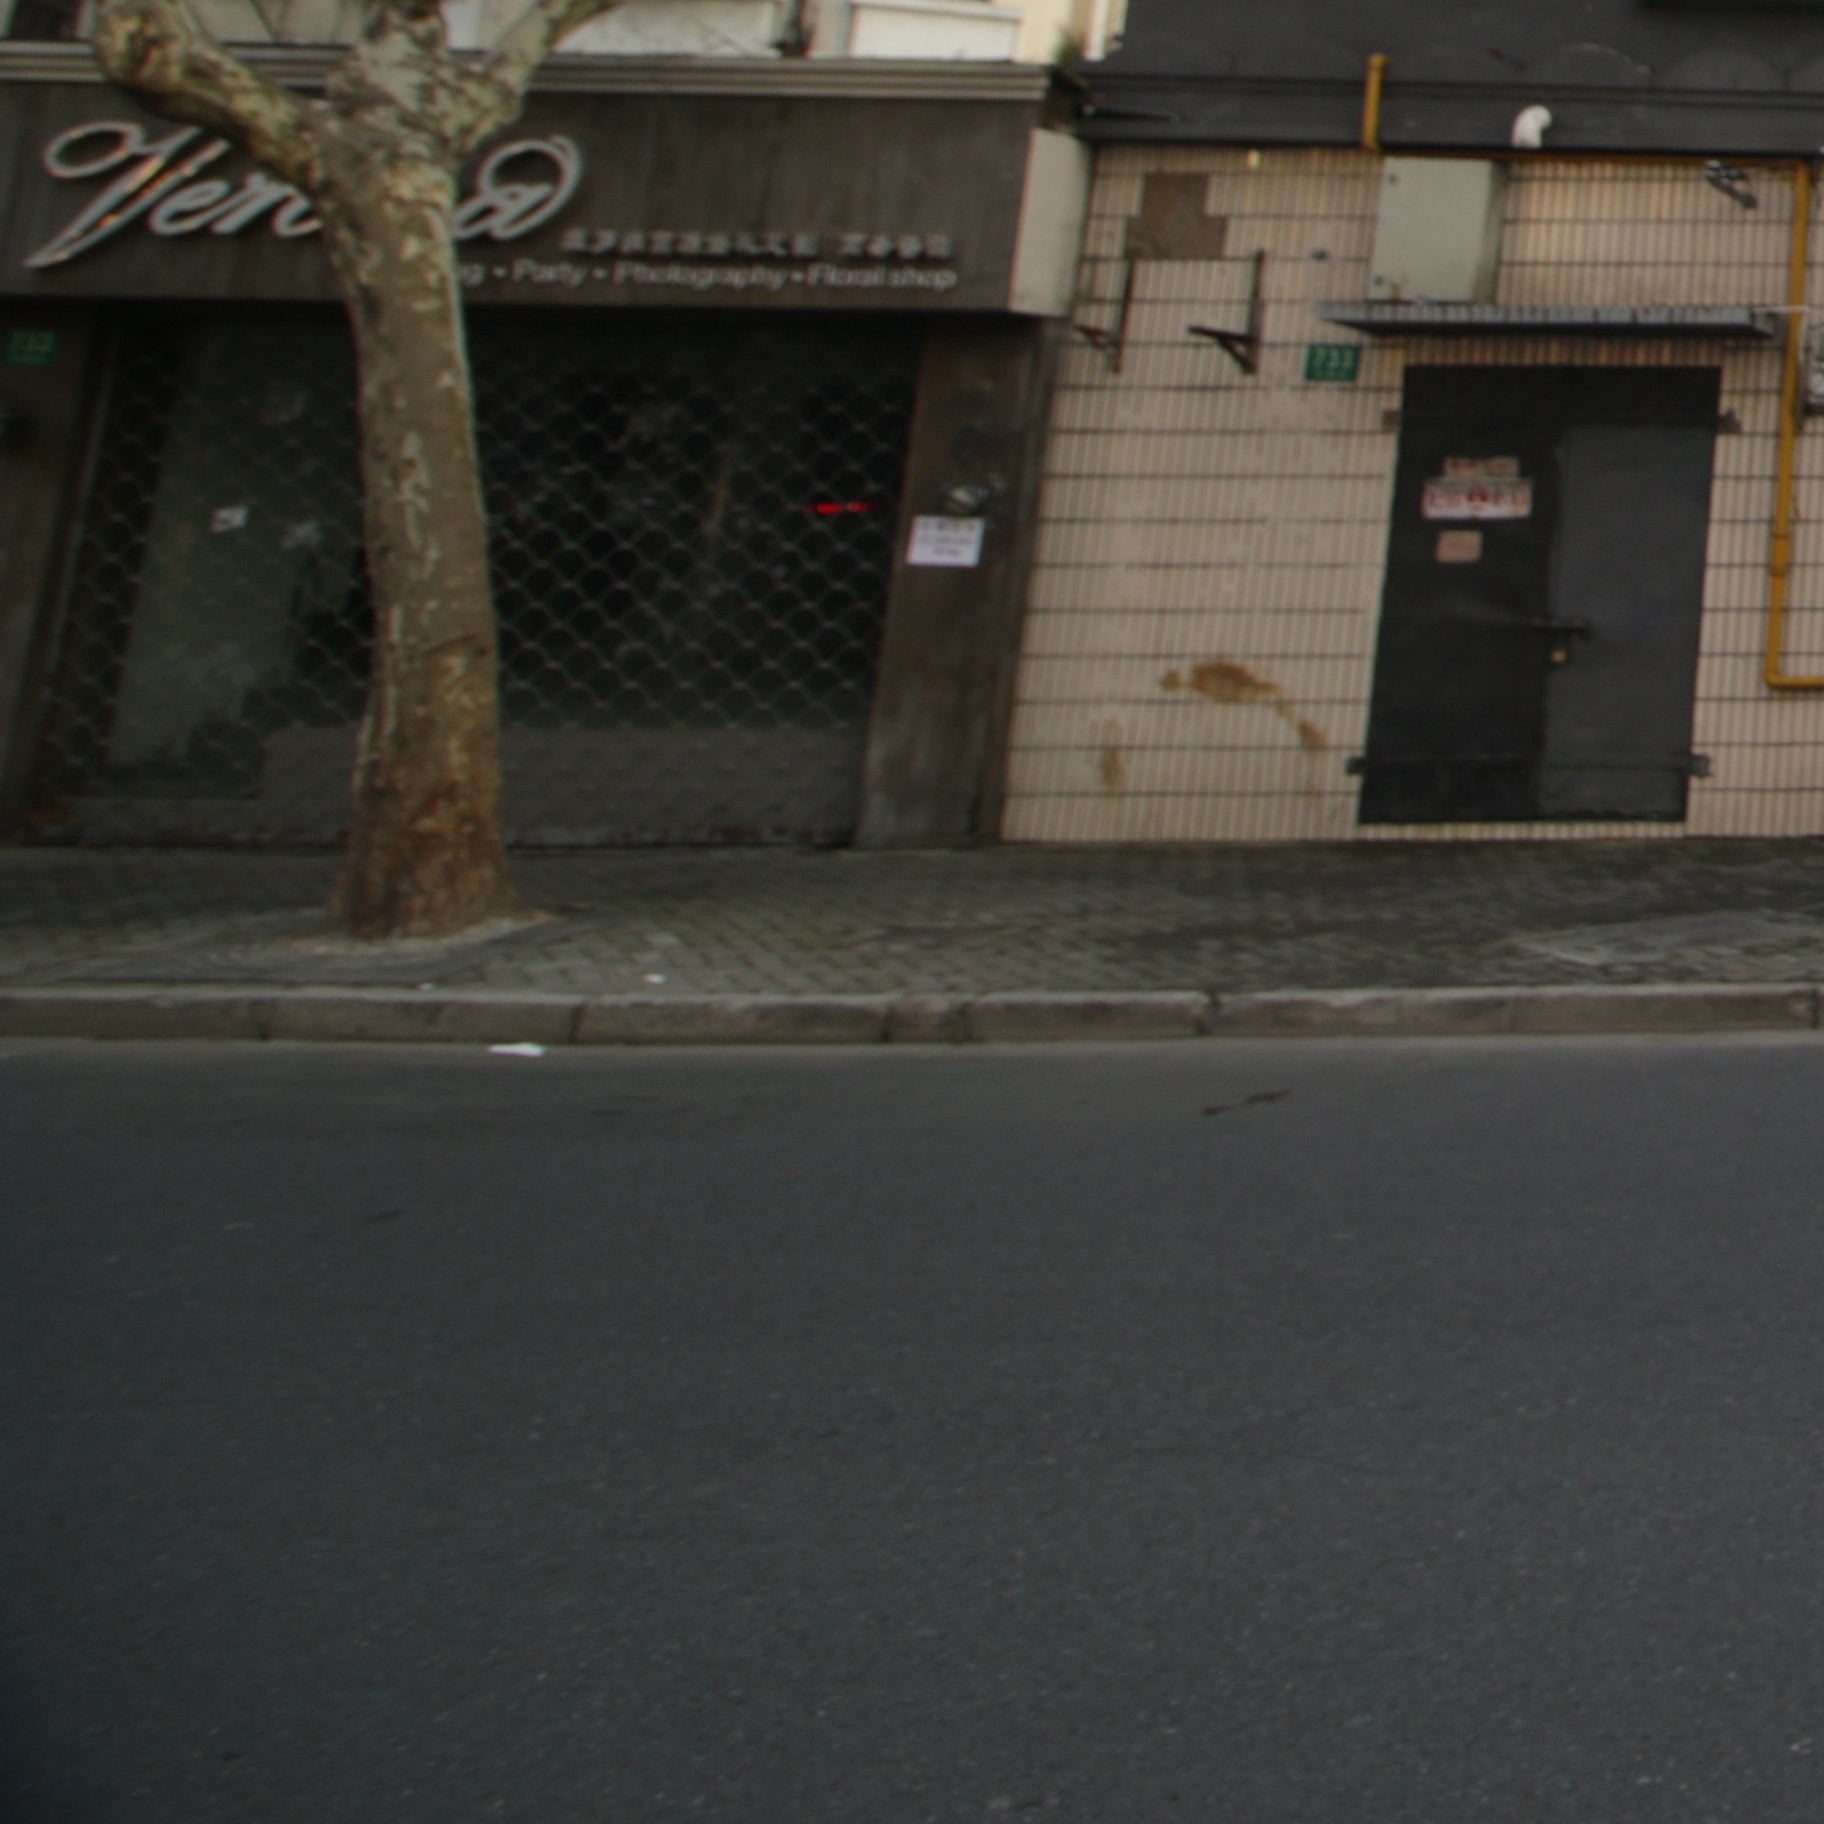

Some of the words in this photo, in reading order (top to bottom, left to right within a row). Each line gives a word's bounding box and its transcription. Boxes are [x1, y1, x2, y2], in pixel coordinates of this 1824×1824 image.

[512, 258, 586, 289] Party
[613, 260, 788, 292] Photography
[888, 266, 958, 292] shop
